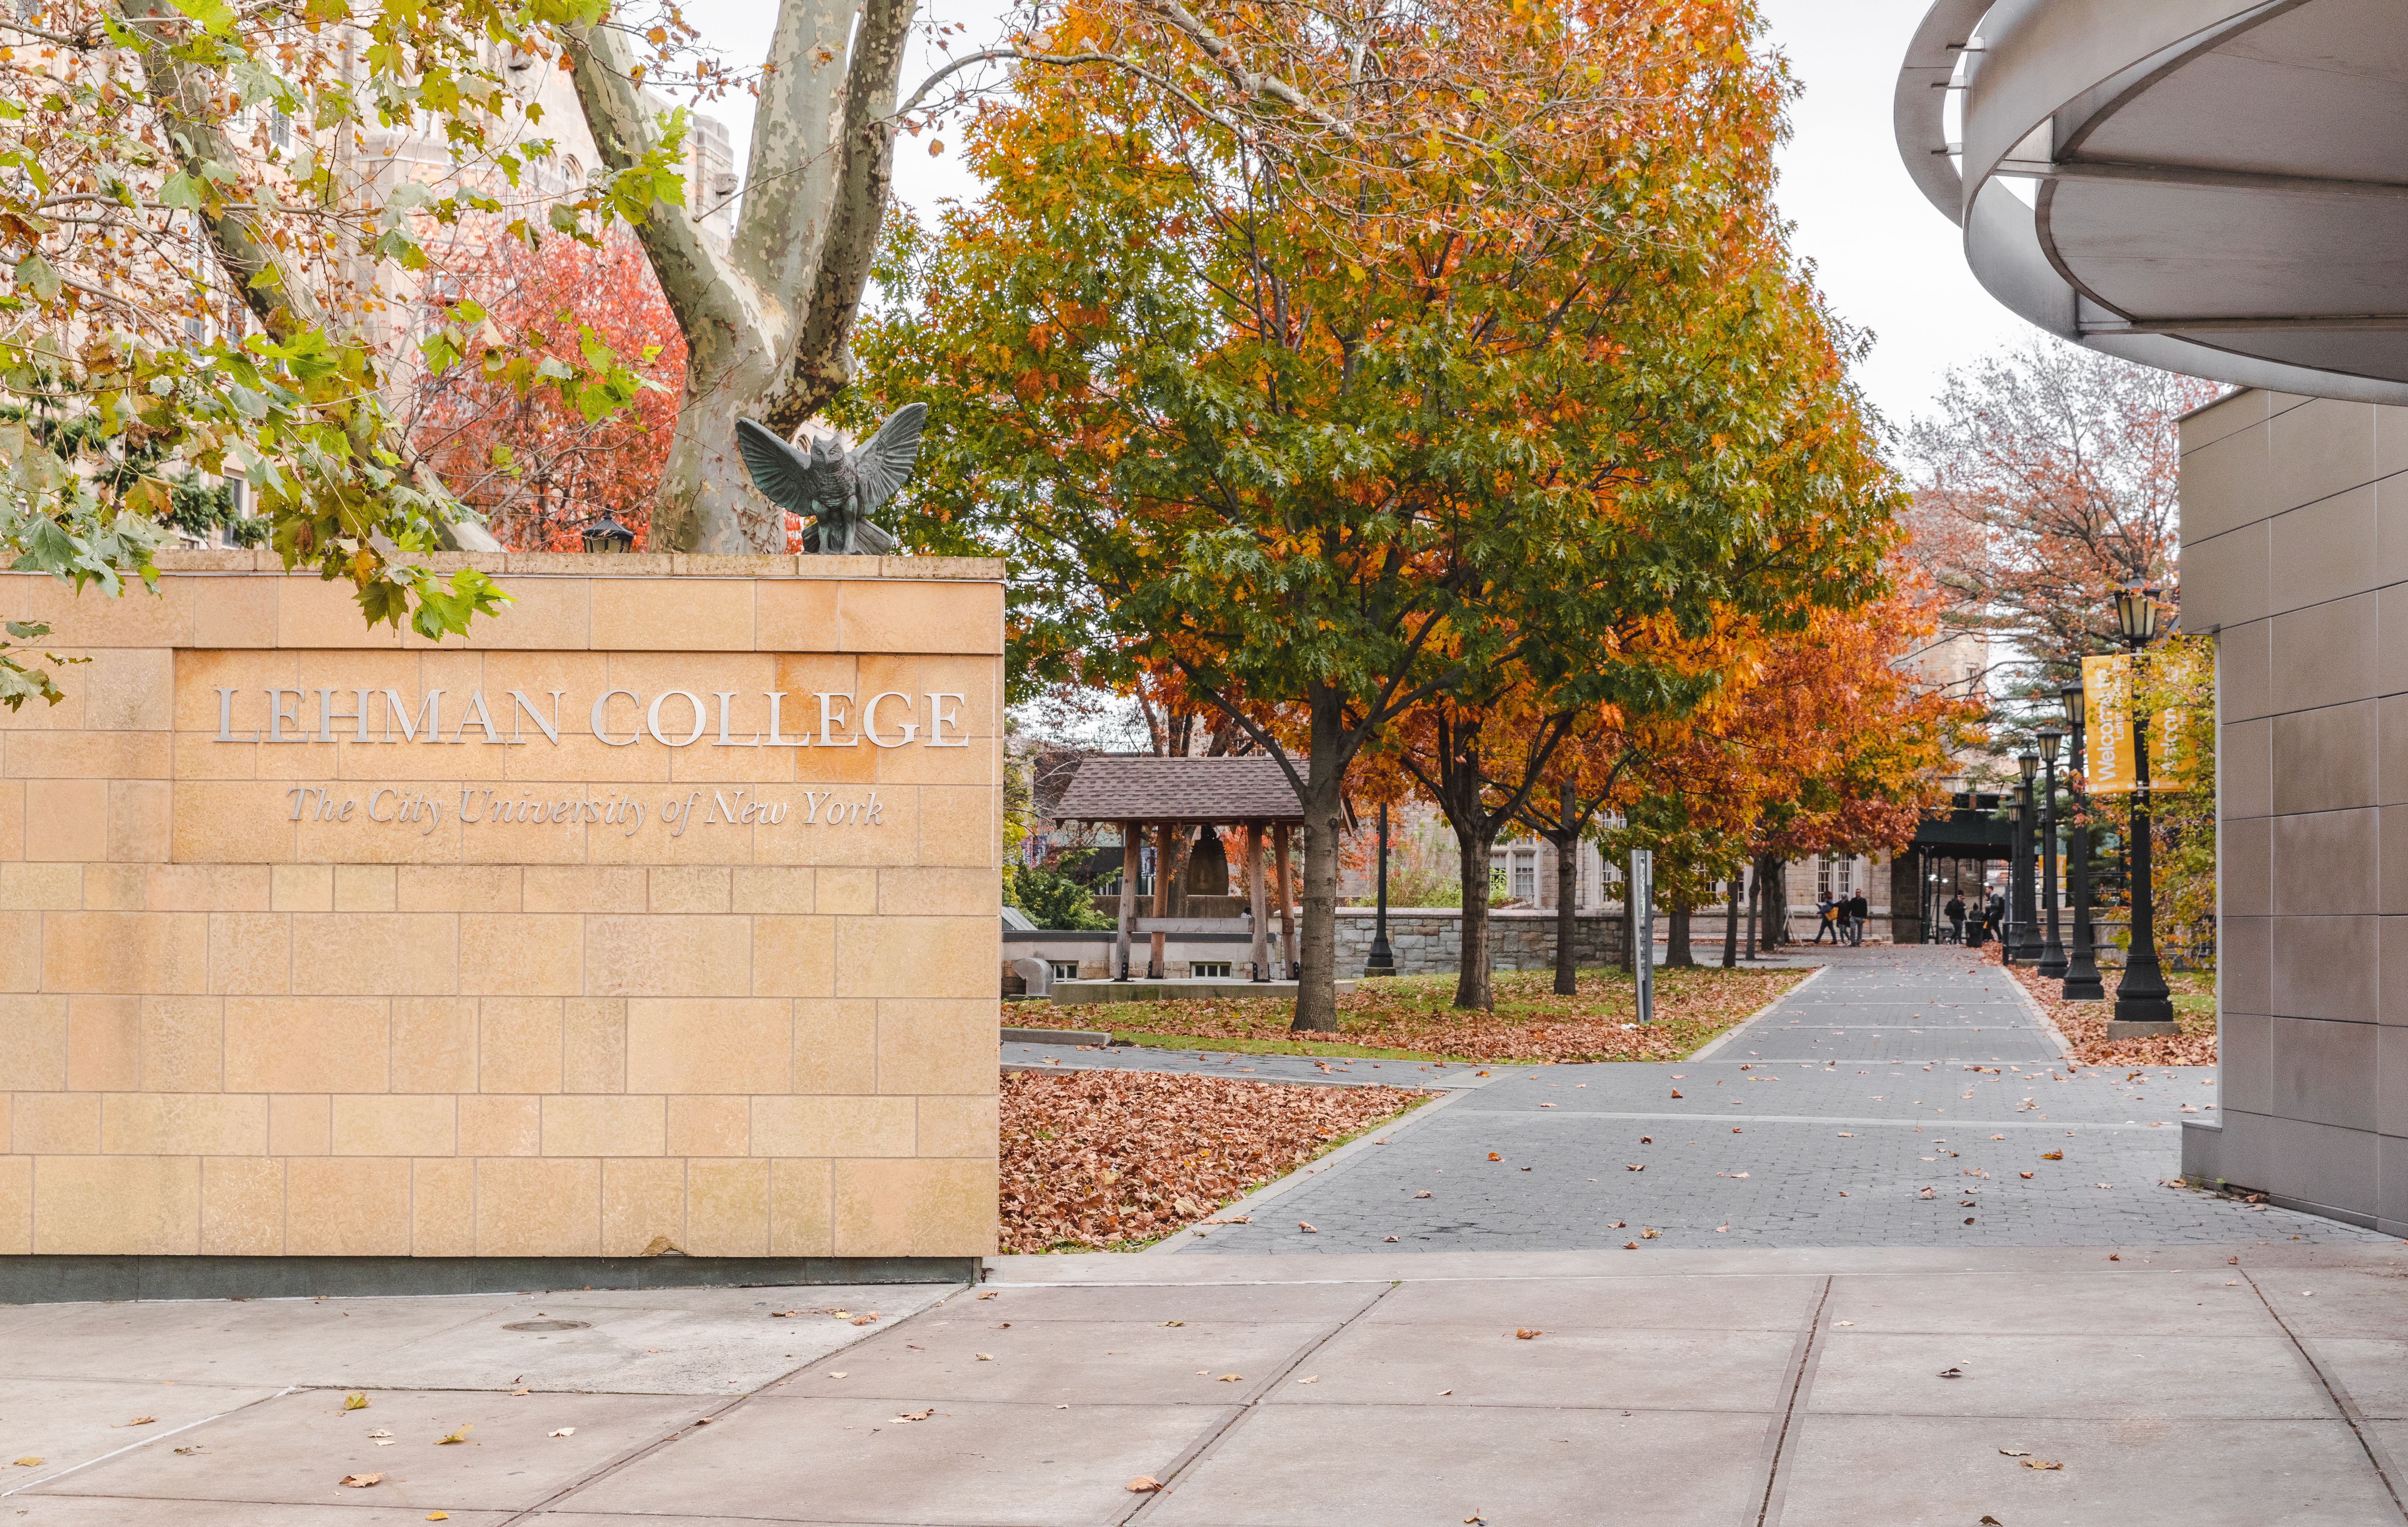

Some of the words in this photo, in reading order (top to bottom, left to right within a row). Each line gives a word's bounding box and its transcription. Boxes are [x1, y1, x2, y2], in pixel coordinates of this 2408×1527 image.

[213, 688, 565, 745] LEHMAN
[590, 689, 969, 748] COLLEGE
[2096, 692, 2116, 782] Welcome
[2114, 699, 2124, 740] Lehmn
[287, 787, 355, 822] The
[369, 789, 443, 835] City
[459, 789, 648, 836] University
[661, 791, 702, 836] of
[705, 790, 787, 824] New
[803, 791, 884, 825] York
